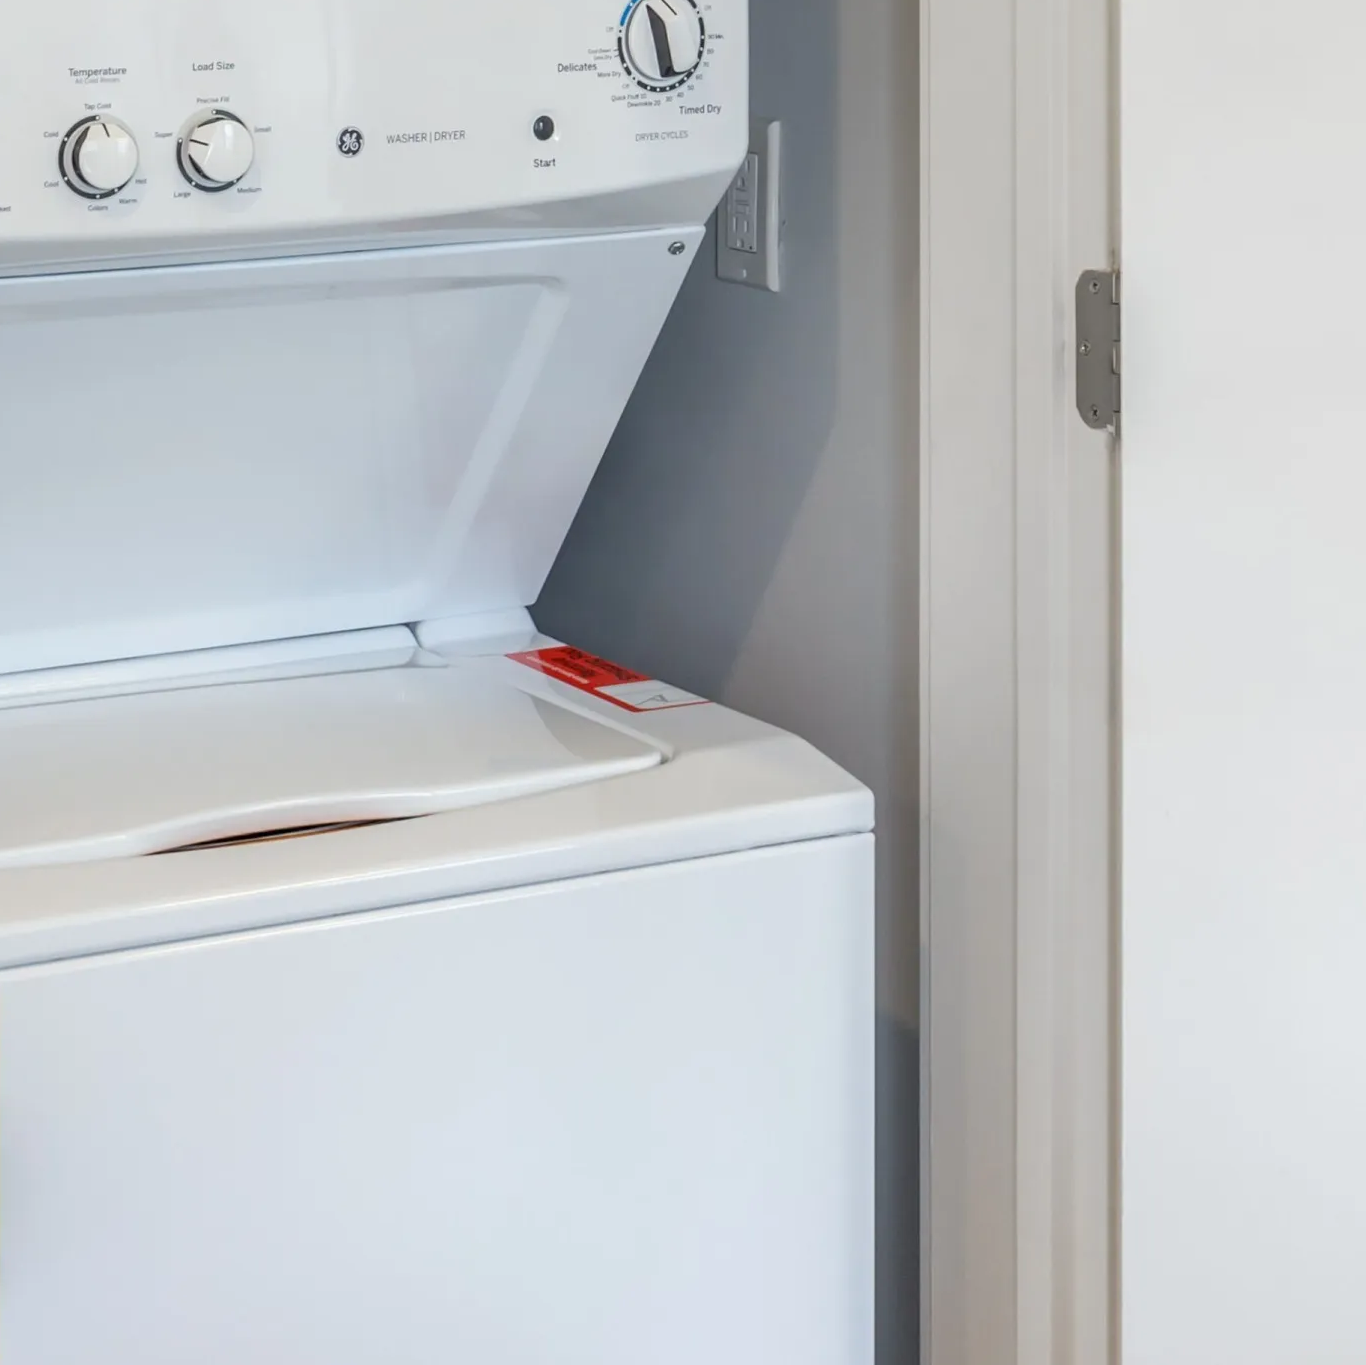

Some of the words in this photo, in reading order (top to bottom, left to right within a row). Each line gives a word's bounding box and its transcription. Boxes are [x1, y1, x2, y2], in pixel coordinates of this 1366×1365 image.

[192, 62, 214, 72] Load
[216, 61, 234, 70] Size
[558, 62, 597, 72] Delicates
[68, 67, 126, 78] Temperature
[679, 106, 704, 114] Timed
[707, 104, 721, 114] Dry
[387, 132, 428, 144] WASHER
[434, 130, 466, 142] DRYER
[636, 132, 659, 142] DRYER
[661, 130, 688, 140] CYCLES
[533, 158, 556, 168] Start
